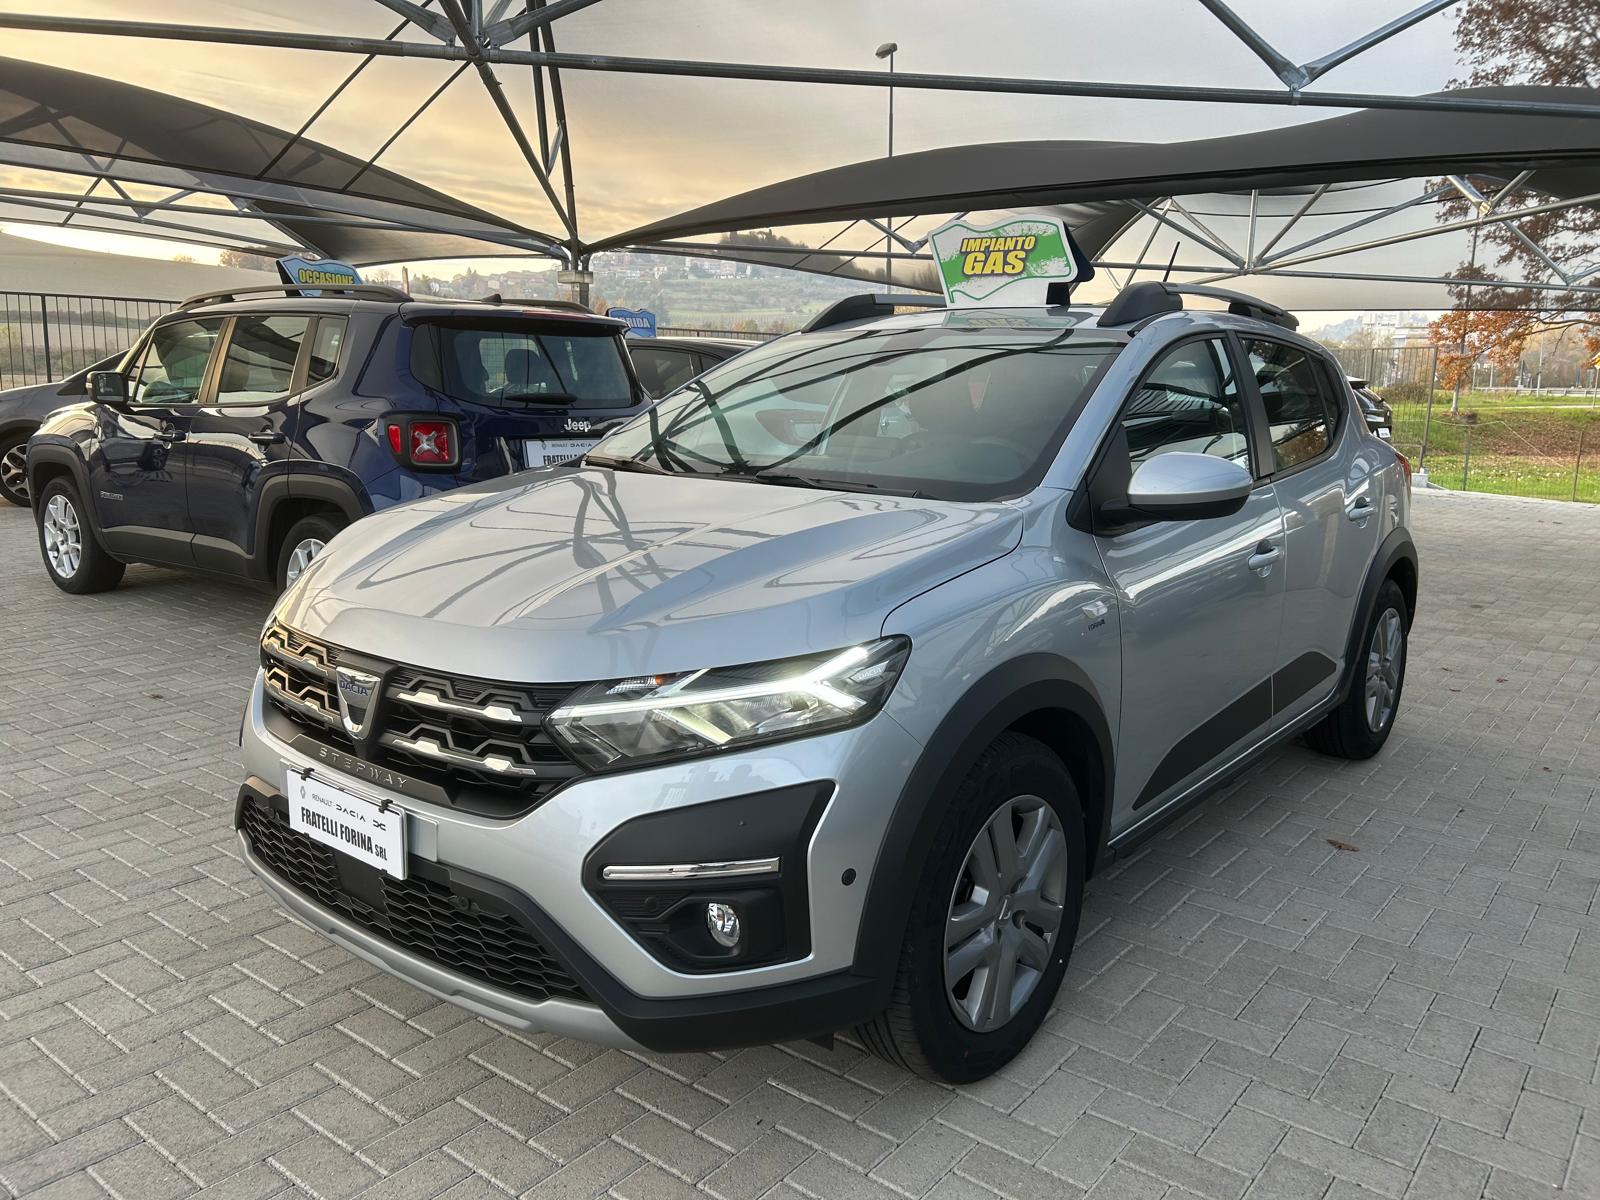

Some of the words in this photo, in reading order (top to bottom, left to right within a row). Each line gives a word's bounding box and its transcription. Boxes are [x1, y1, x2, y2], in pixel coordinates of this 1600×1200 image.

[960, 235, 1036, 253] IMPIANTO
[963, 250, 1026, 276] GAS
[298, 268, 354, 285] OCCASIONE
[617, 317, 651, 328] RIDA
[563, 418, 592, 433] Jeep
[340, 680, 368, 697] DACIA
[319, 747, 407, 788] STEPWAY
[312, 793, 333, 807] RENAULT
[335, 803, 366, 823] DACIA
[300, 806, 339, 838] FRATELLI
[339, 823, 374, 855] FORINA
[374, 844, 388, 861] SRL
